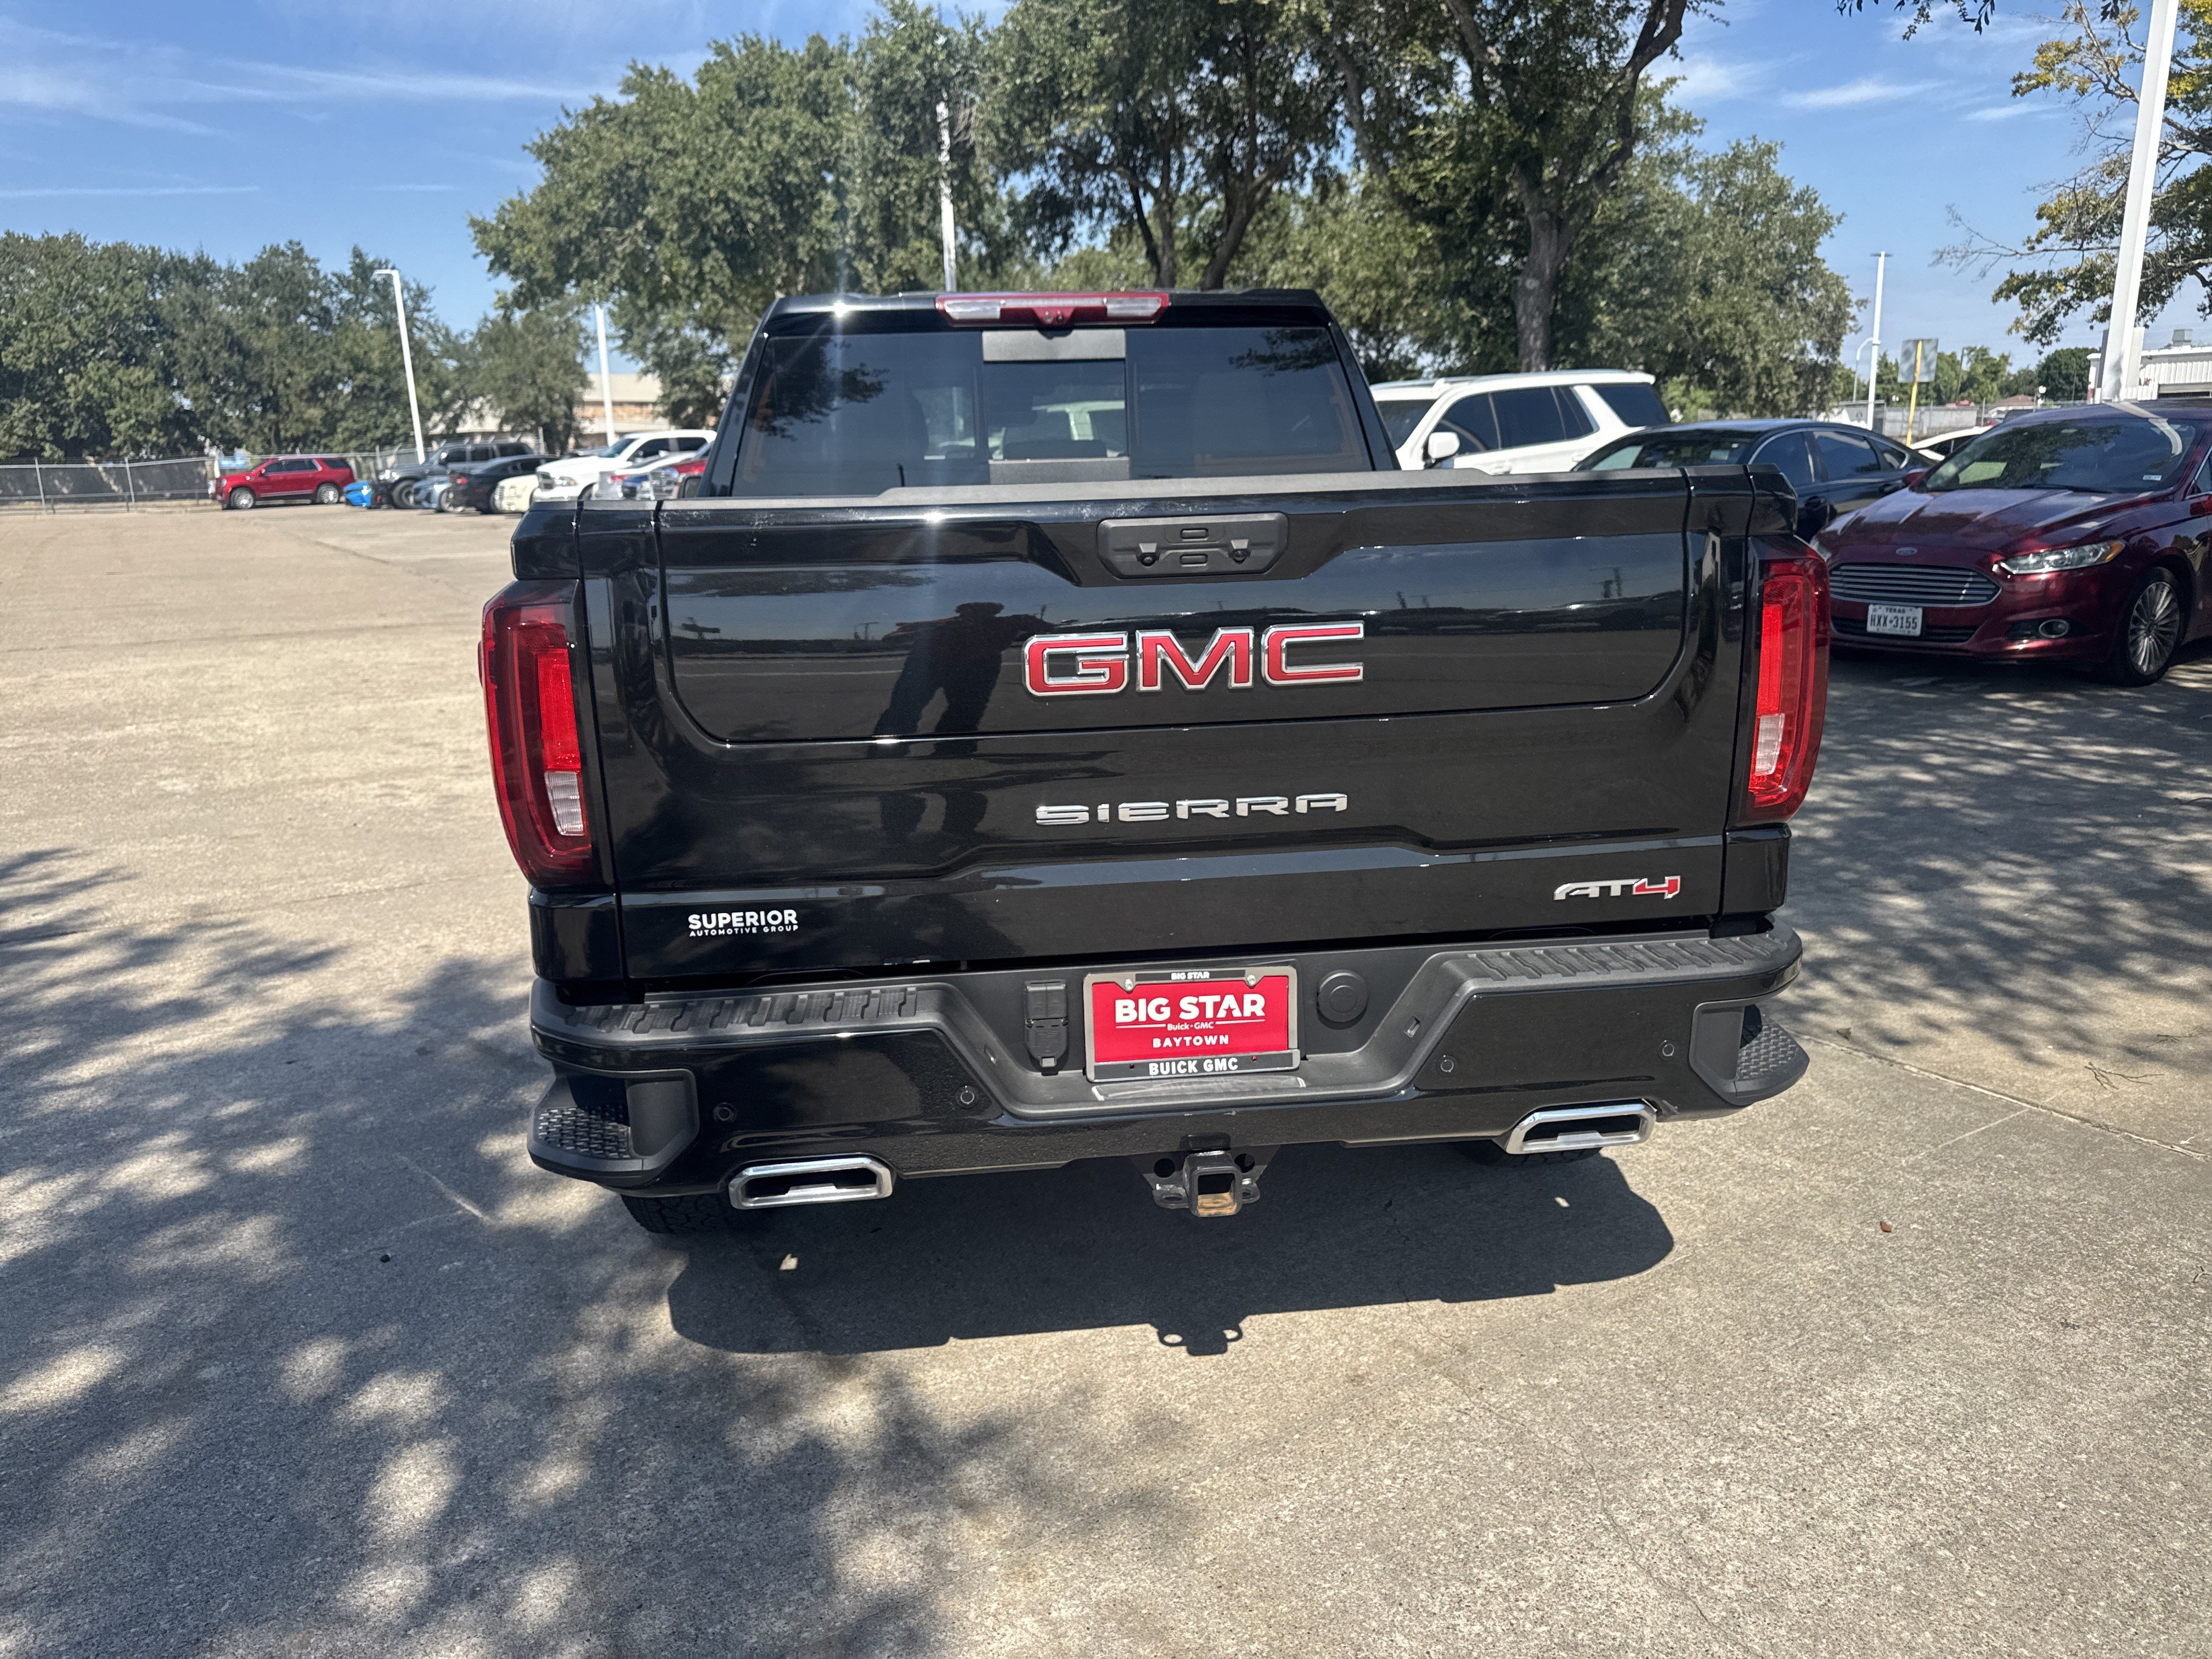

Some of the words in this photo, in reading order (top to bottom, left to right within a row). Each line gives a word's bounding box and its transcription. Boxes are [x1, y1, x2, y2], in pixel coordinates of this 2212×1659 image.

[1024, 620, 1364, 696] GMC
[1036, 793, 1347, 825] SIERRA
[1554, 876, 1680, 900] AT4
[688, 909, 798, 929] SUPERIOR
[690, 927, 757, 936] AUTOMOTIVE
[1171, 972, 1186, 980] BIG
[1187, 971, 1210, 979] STAR
[1115, 997, 1171, 1023] BIG
[1179, 994, 1265, 1020] STAR
[1153, 1035, 1229, 1048] BAYTOWN
[1149, 1060, 1198, 1075] BUICK
[1203, 1058, 1238, 1072] GMC
